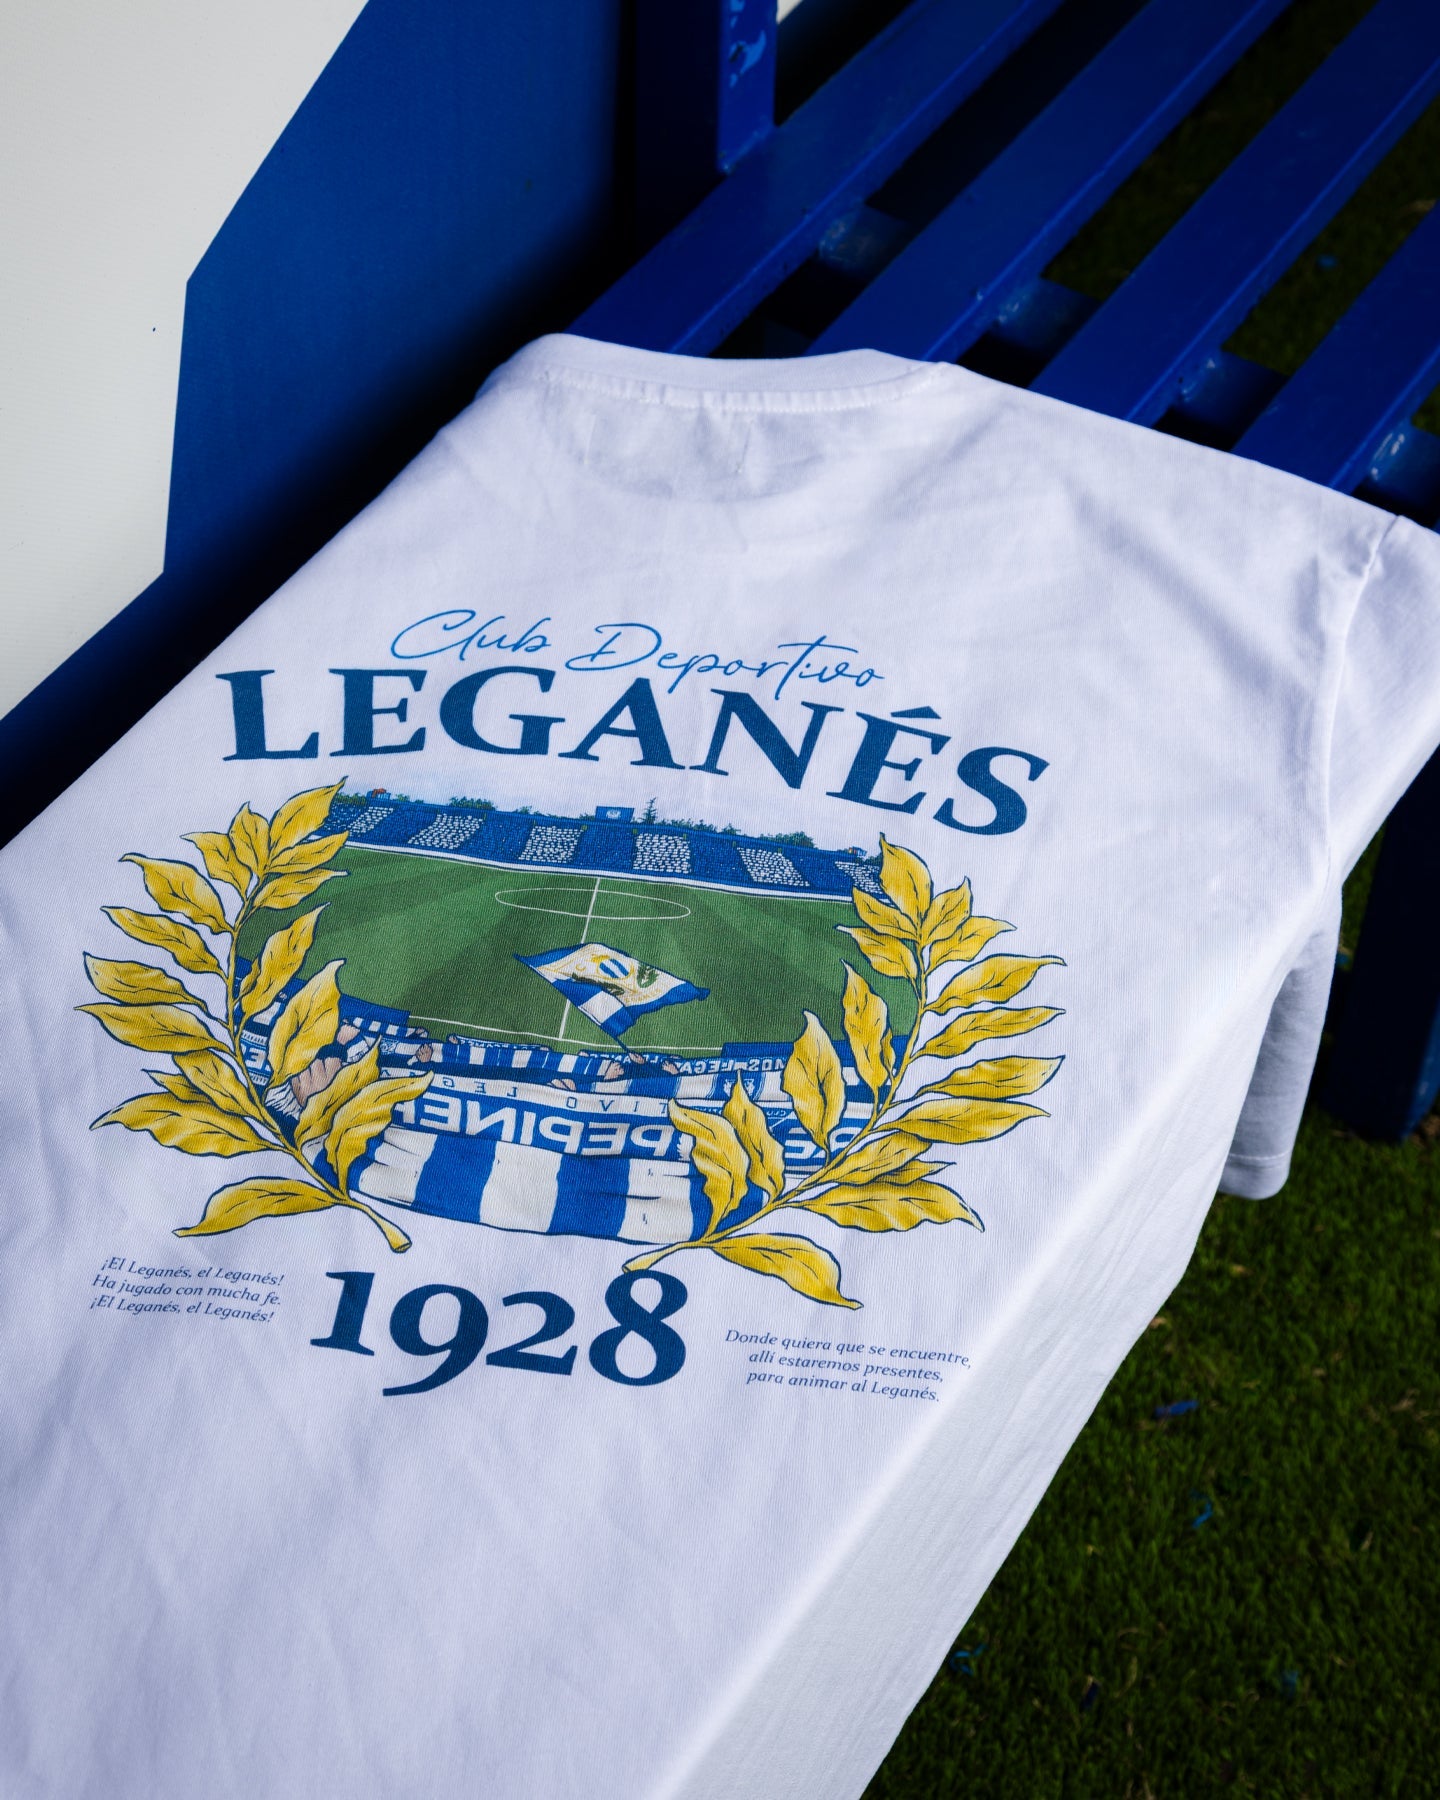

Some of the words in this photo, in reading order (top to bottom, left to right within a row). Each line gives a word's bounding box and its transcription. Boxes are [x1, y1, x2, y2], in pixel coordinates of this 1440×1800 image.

[390, 609, 552, 662] Club
[565, 622, 885, 701] Deportivo
[215, 665, 1050, 836] LEGANÉS
[101, 1257, 125, 1271] ¡El
[128, 1261, 192, 1278] Leganés,
[197, 1267, 213, 1278] el
[214, 1268, 285, 1286] Leganés!
[93, 1274, 116, 1289] Ha
[118, 1280, 172, 1297] jugado
[176, 1287, 203, 1296] con
[207, 1287, 260, 1302] mucha
[260, 1291, 281, 1306] fe.
[90, 1295, 115, 1310] ¡El
[117, 1299, 181, 1316] Leganés,
[186, 1302, 201, 1313] el
[204, 1303, 275, 1323] Leganés!
[310, 1269, 688, 1396] 1928
[725, 1329, 779, 1346] Donde
[781, 1337, 832, 1353] quiera
[836, 1343, 866, 1357] que
[868, 1346, 887, 1356] se
[889, 1349, 972, 1369] encuentre,
[749, 1350, 775, 1363] allí
[778, 1356, 861, 1372] estaremos
[863, 1363, 945, 1383] presentes,
[746, 1370, 784, 1385] para
[788, 1373, 848, 1391] animar
[851, 1379, 868, 1393] al
[871, 1382, 940, 1402] Leganés.
